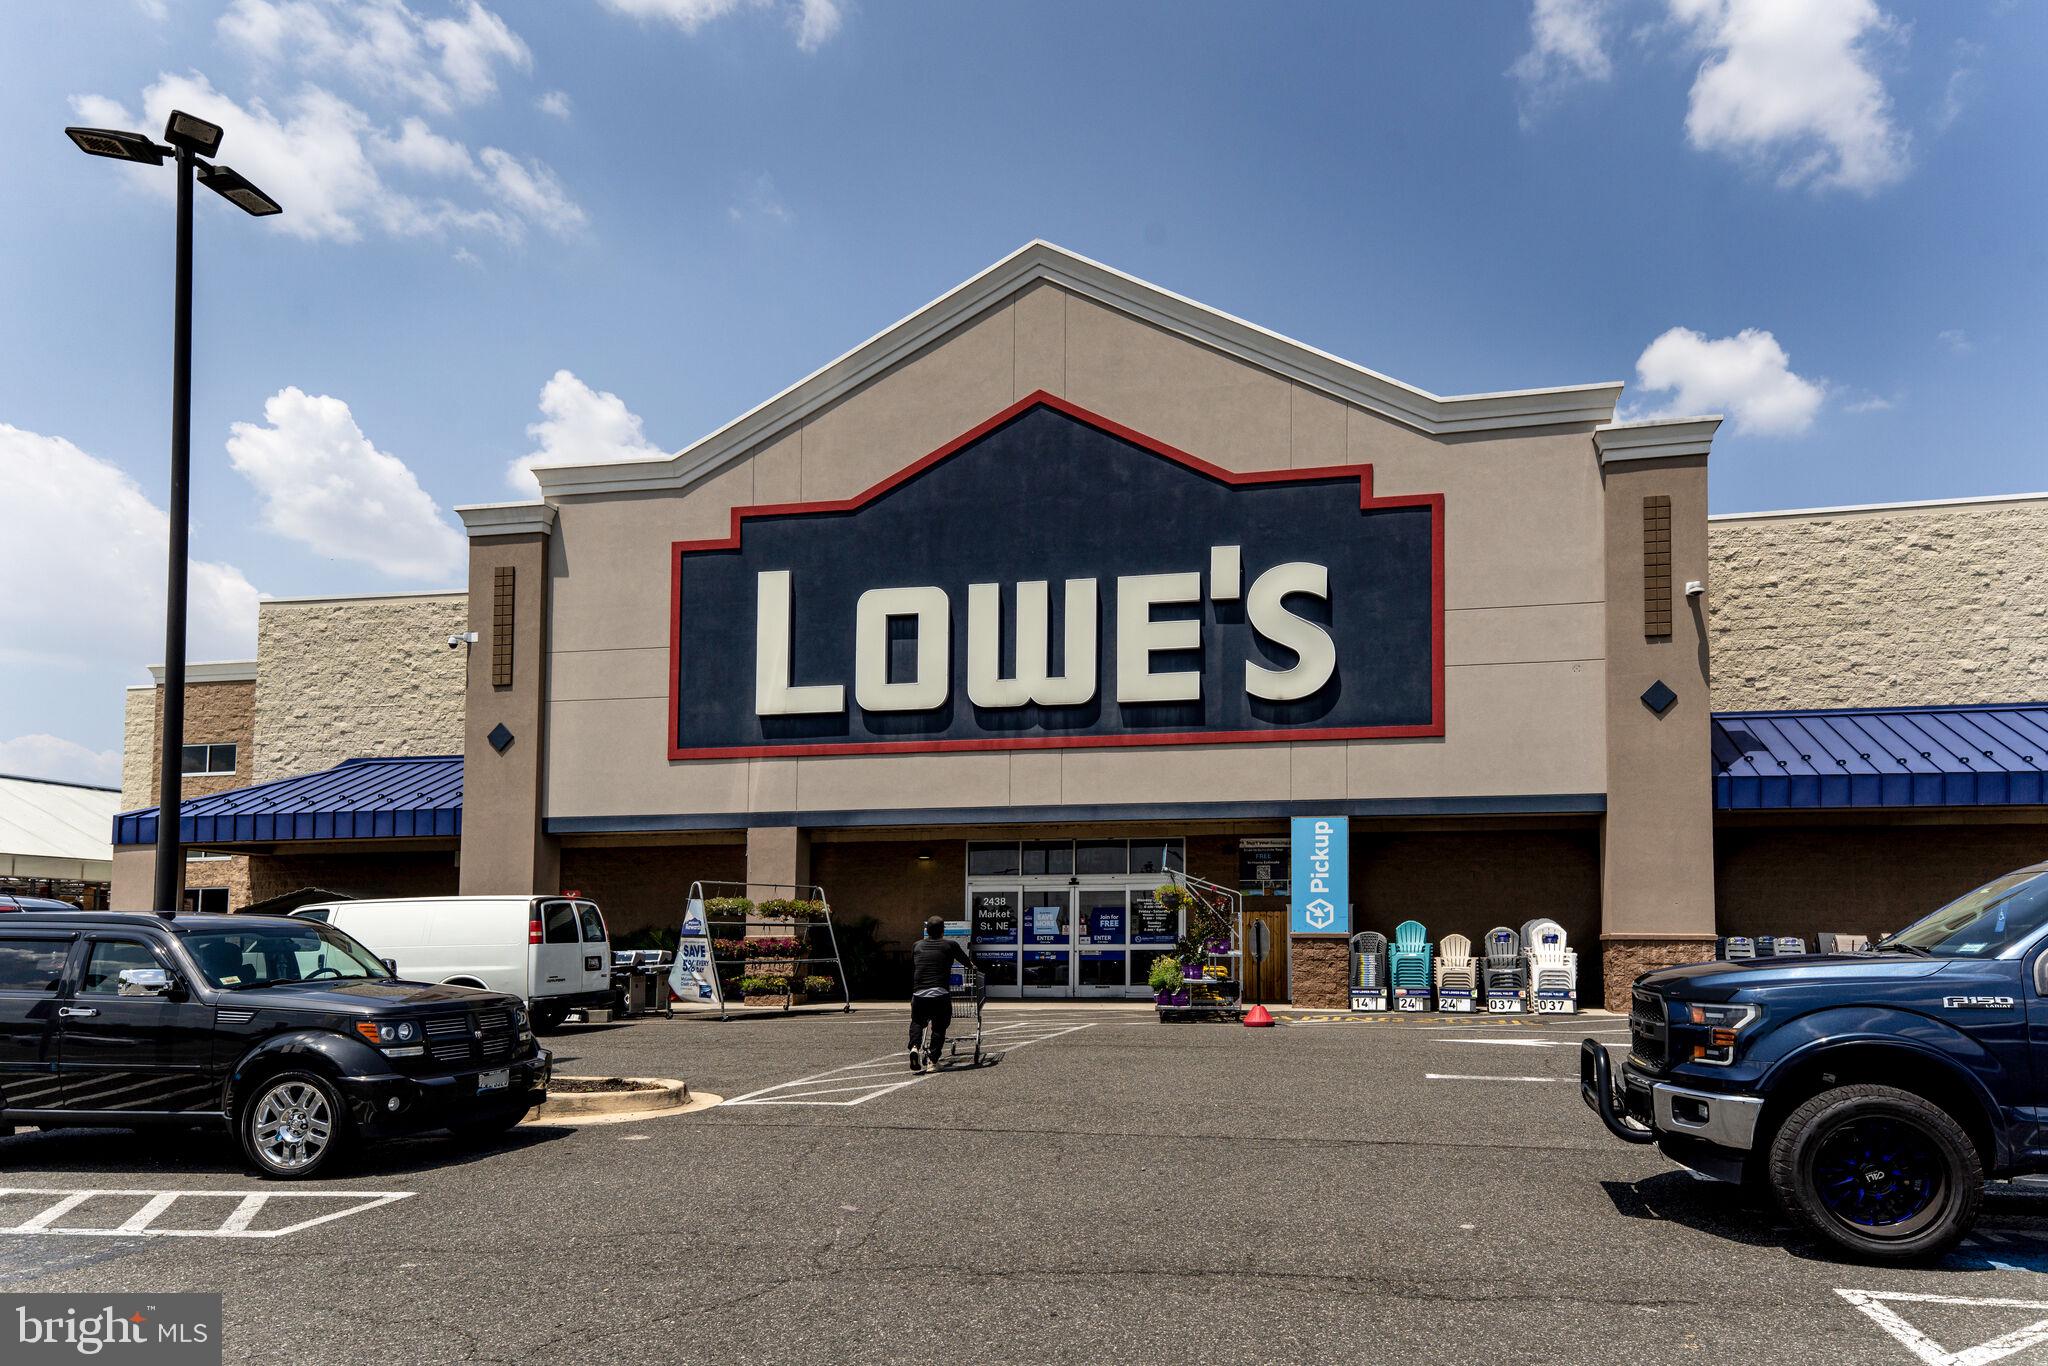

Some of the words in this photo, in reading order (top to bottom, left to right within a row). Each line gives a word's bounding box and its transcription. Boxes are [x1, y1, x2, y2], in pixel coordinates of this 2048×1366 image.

[756, 545, 1336, 714] LOWE'S
[1310, 821, 1334, 893] Pickup
[983, 897, 1006, 906] 2438
[978, 909, 1011, 918] Market
[980, 921, 993, 930] St.
[996, 921, 1009, 930] NE
[1100, 919, 1119, 927] FREE
[683, 944, 706, 958] SAVE
[682, 959, 696, 972] 5%
[1401, 998, 1415, 1009] 24
[1440, 999, 1456, 1009] 24
[1490, 999, 1513, 1010] 037
[1539, 1000, 1565, 1011] 037
